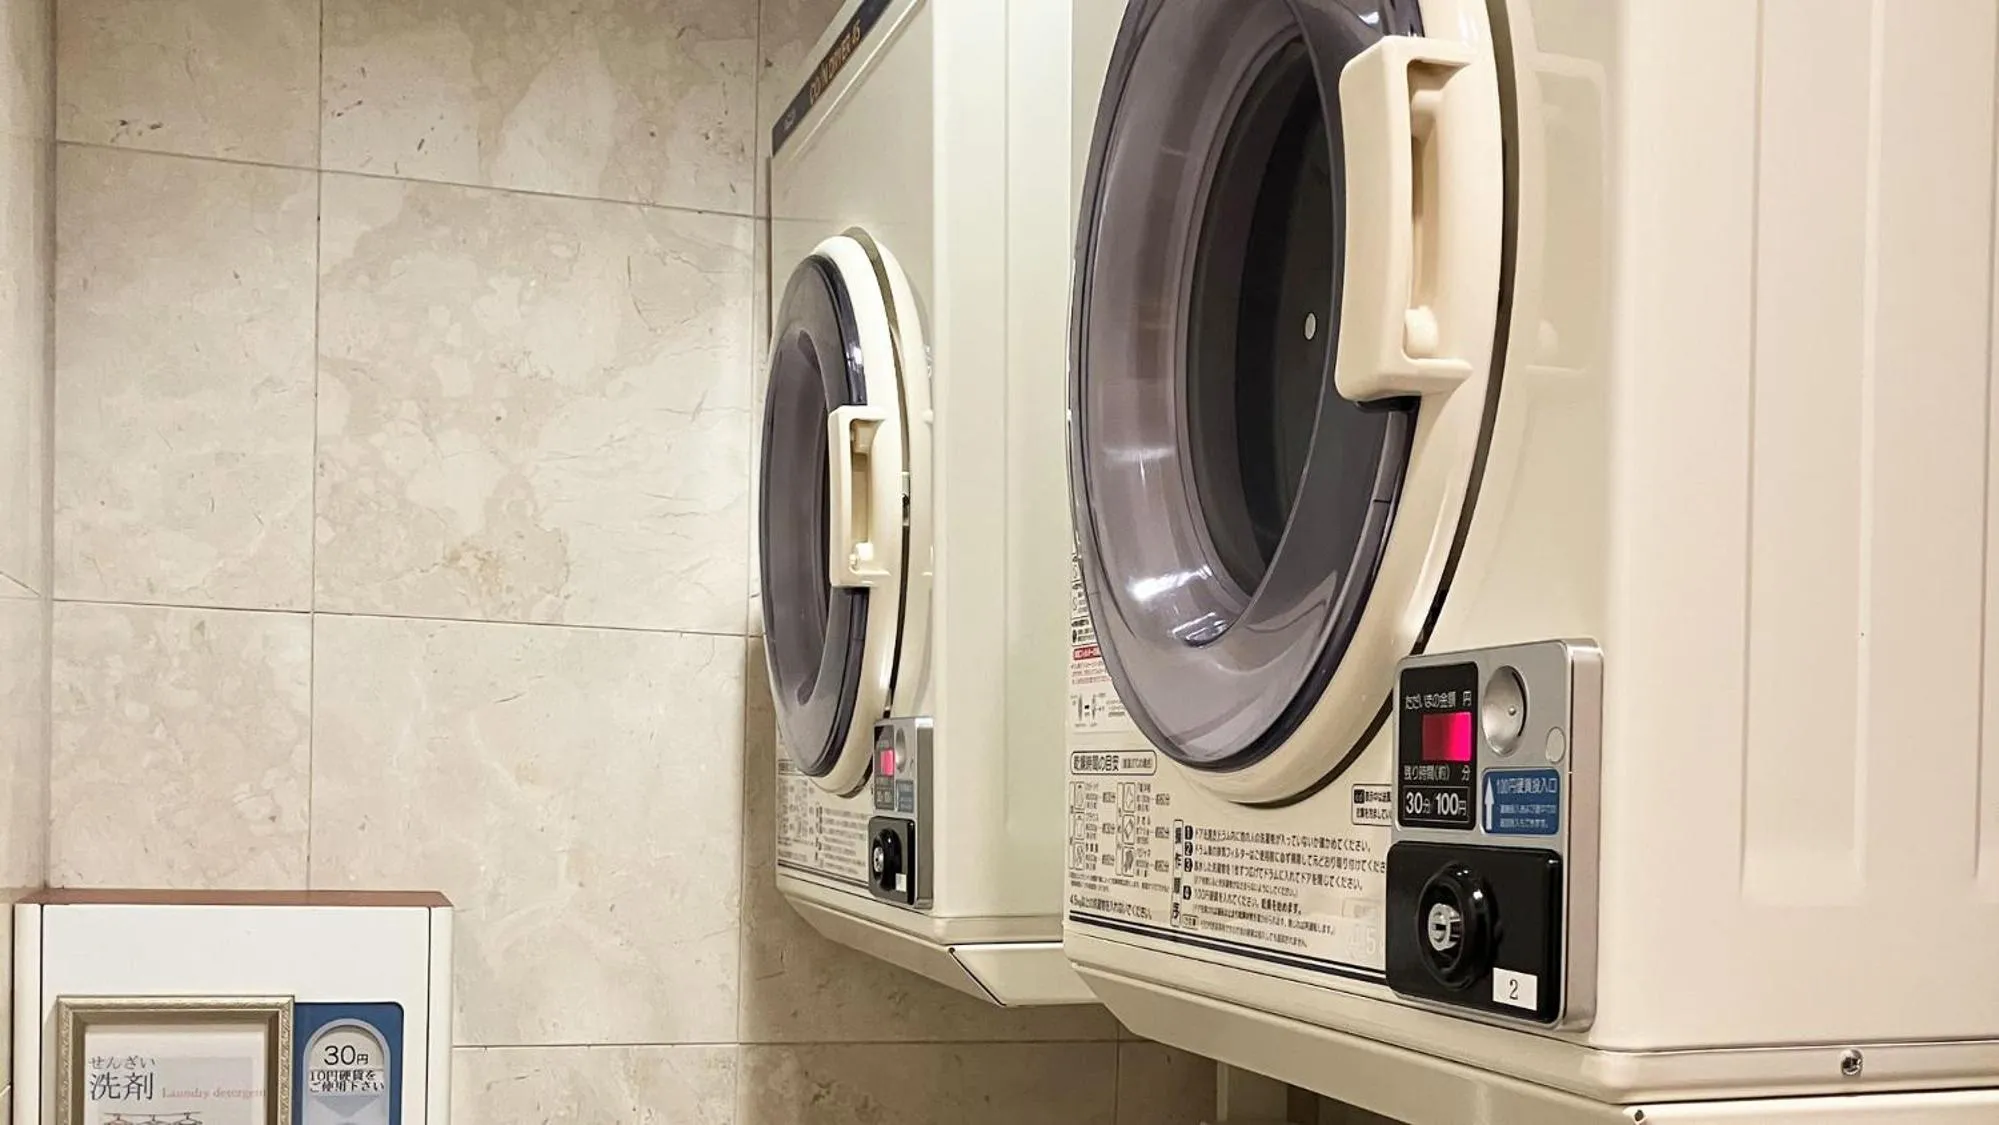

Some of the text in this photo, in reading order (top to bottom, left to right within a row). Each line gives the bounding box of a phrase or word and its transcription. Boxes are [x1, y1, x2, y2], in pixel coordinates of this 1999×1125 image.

[1435, 792, 1466, 815] 100円
[1509, 978, 1518, 1000] 2
[88, 1055, 155, 1070] せんざい
[323, 1044, 368, 1065] 30円
[310, 1070, 376, 1081] 10円硬貨を
[89, 1072, 154, 1101] 洗剤
[162, 1088, 209, 1099] Laundry
[309, 1080, 385, 1092] ご使用下さい
